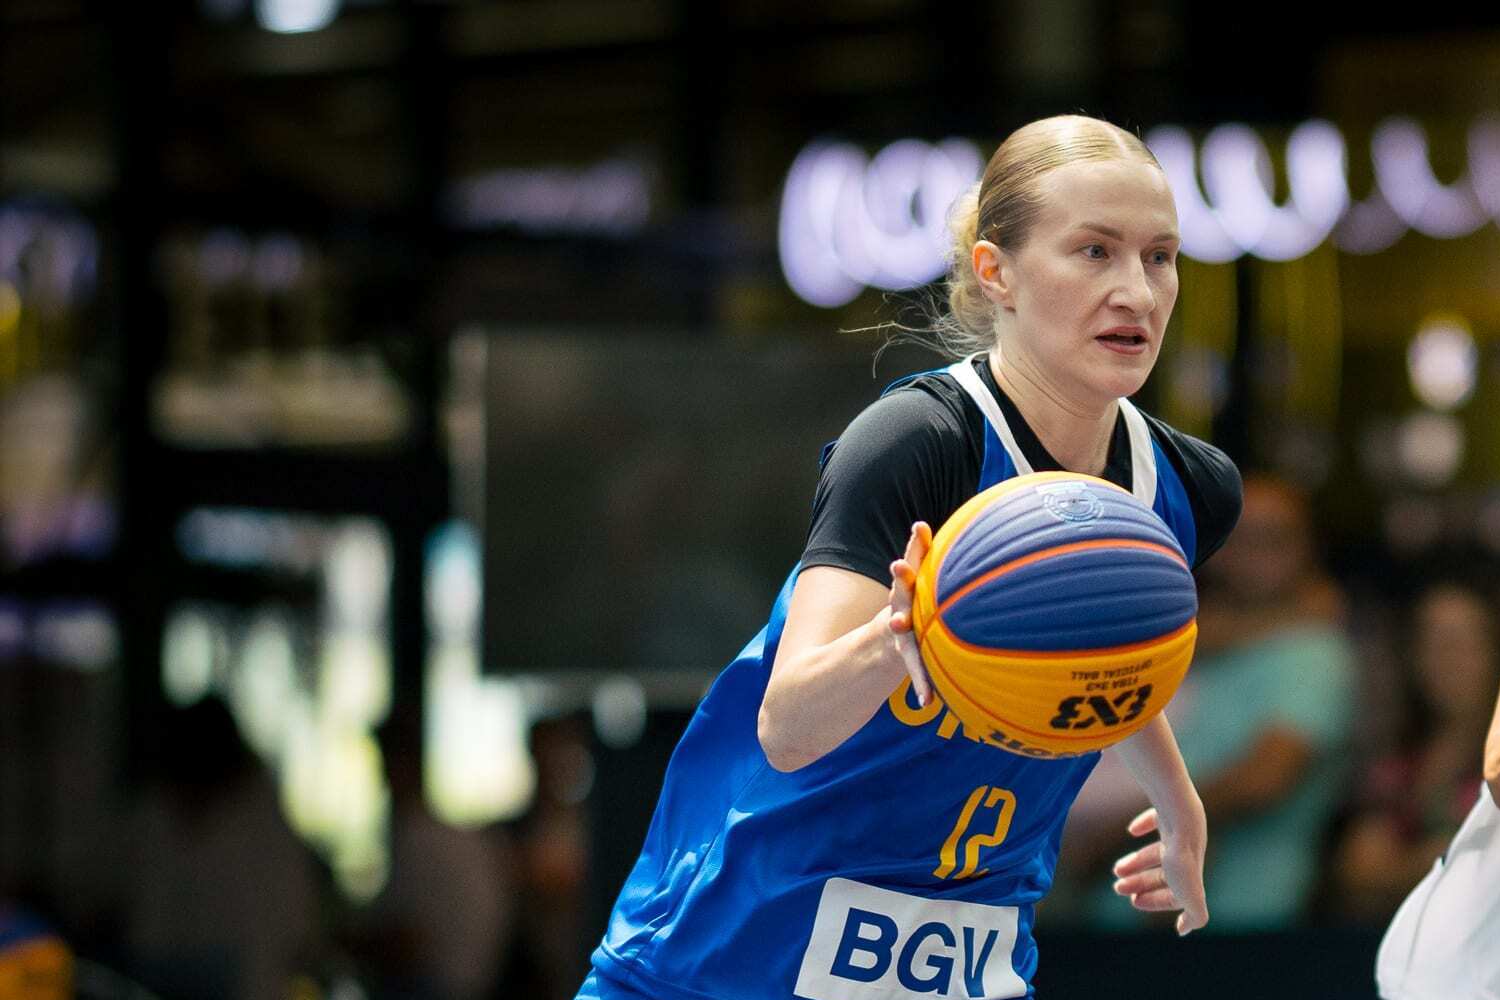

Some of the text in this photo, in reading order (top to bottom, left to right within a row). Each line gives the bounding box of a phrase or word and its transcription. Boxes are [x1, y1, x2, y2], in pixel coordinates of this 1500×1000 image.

[1072, 659, 1153, 681] OFFICIAL BALL
[1112, 676, 1138, 689] FIBA
[932, 784, 1017, 880] 12
[829, 896, 999, 999] BGV
